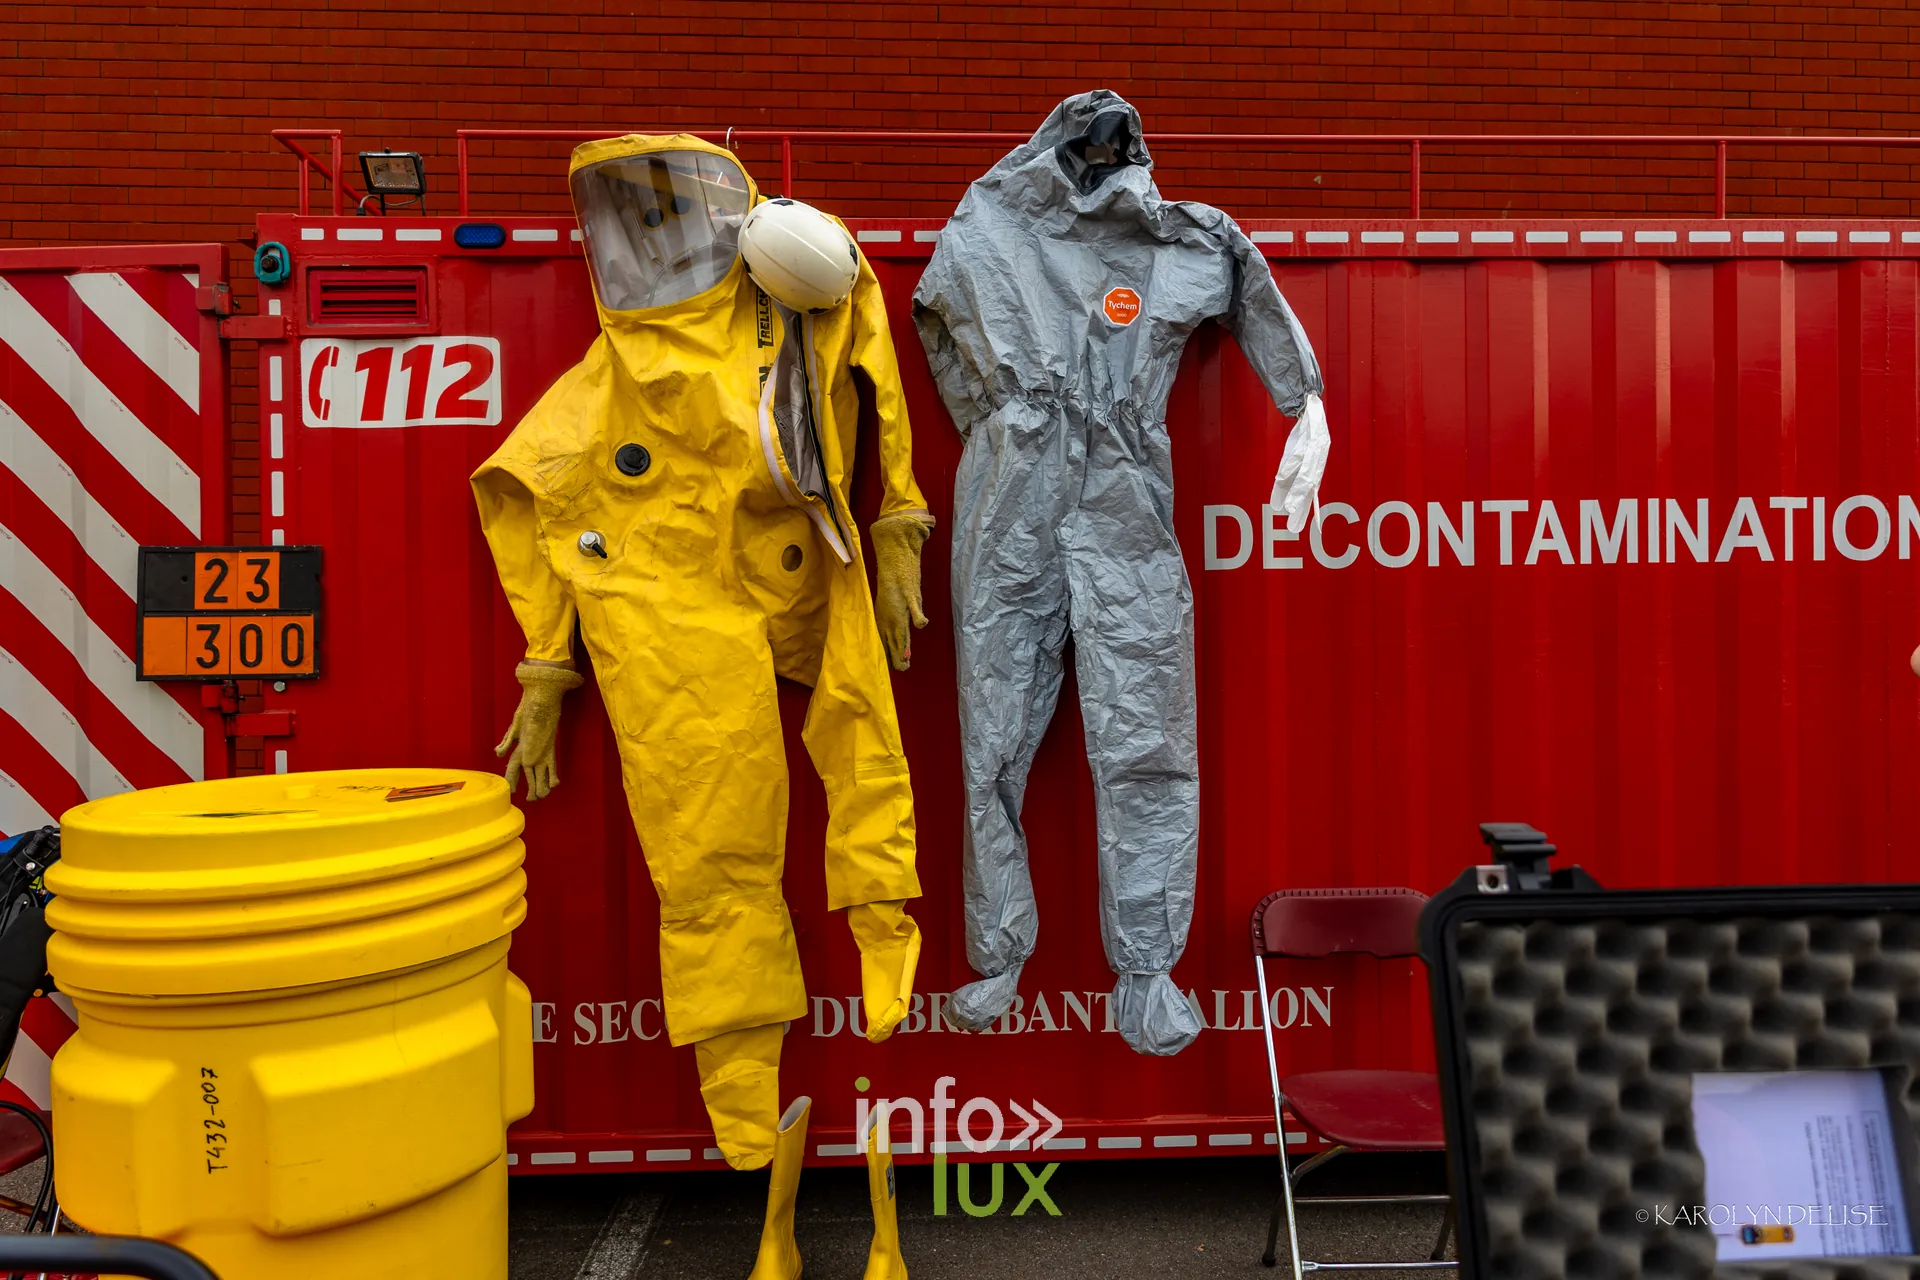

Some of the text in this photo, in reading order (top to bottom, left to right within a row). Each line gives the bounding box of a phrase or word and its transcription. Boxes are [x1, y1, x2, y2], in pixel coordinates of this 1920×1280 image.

[1108, 300, 1137, 310] Tychem
[355, 343, 494, 421] 112
[204, 558, 270, 603] 23
[196, 623, 304, 668] 300
[532, 1001, 558, 1044] E
[897, 990, 1119, 1035] BRBANT
[1180, 986, 1335, 1031] ALLON
[201, 1066, 228, 1174] T432-007
